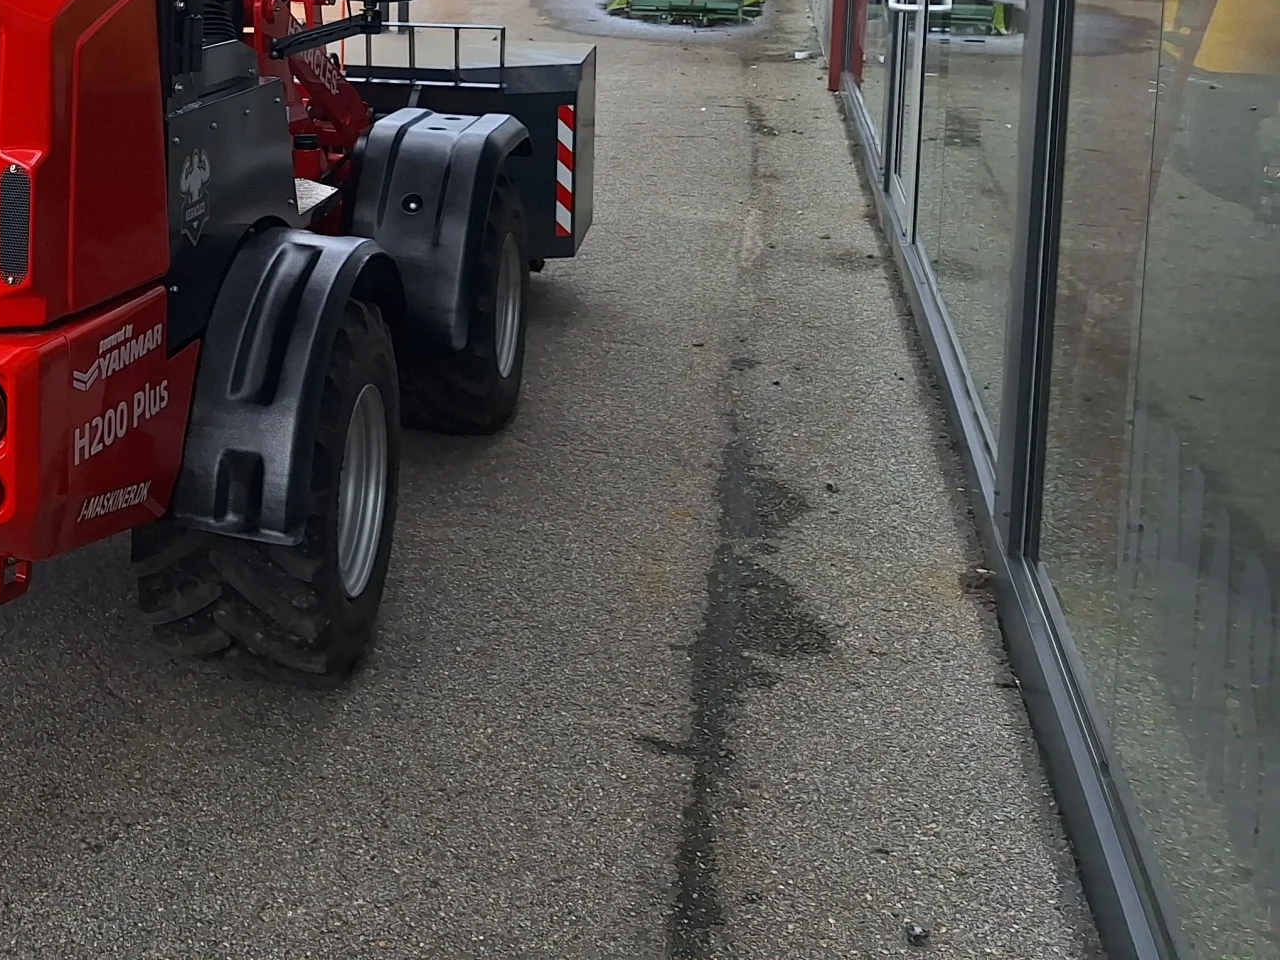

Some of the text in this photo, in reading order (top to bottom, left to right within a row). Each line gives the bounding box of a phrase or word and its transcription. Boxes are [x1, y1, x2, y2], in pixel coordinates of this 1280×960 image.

[98, 323, 134, 355] powered by
[98, 323, 163, 380] YANMAR
[74, 379, 169, 466] H200 Plus
[76, 480, 152, 523] J-MASKINER.DK
